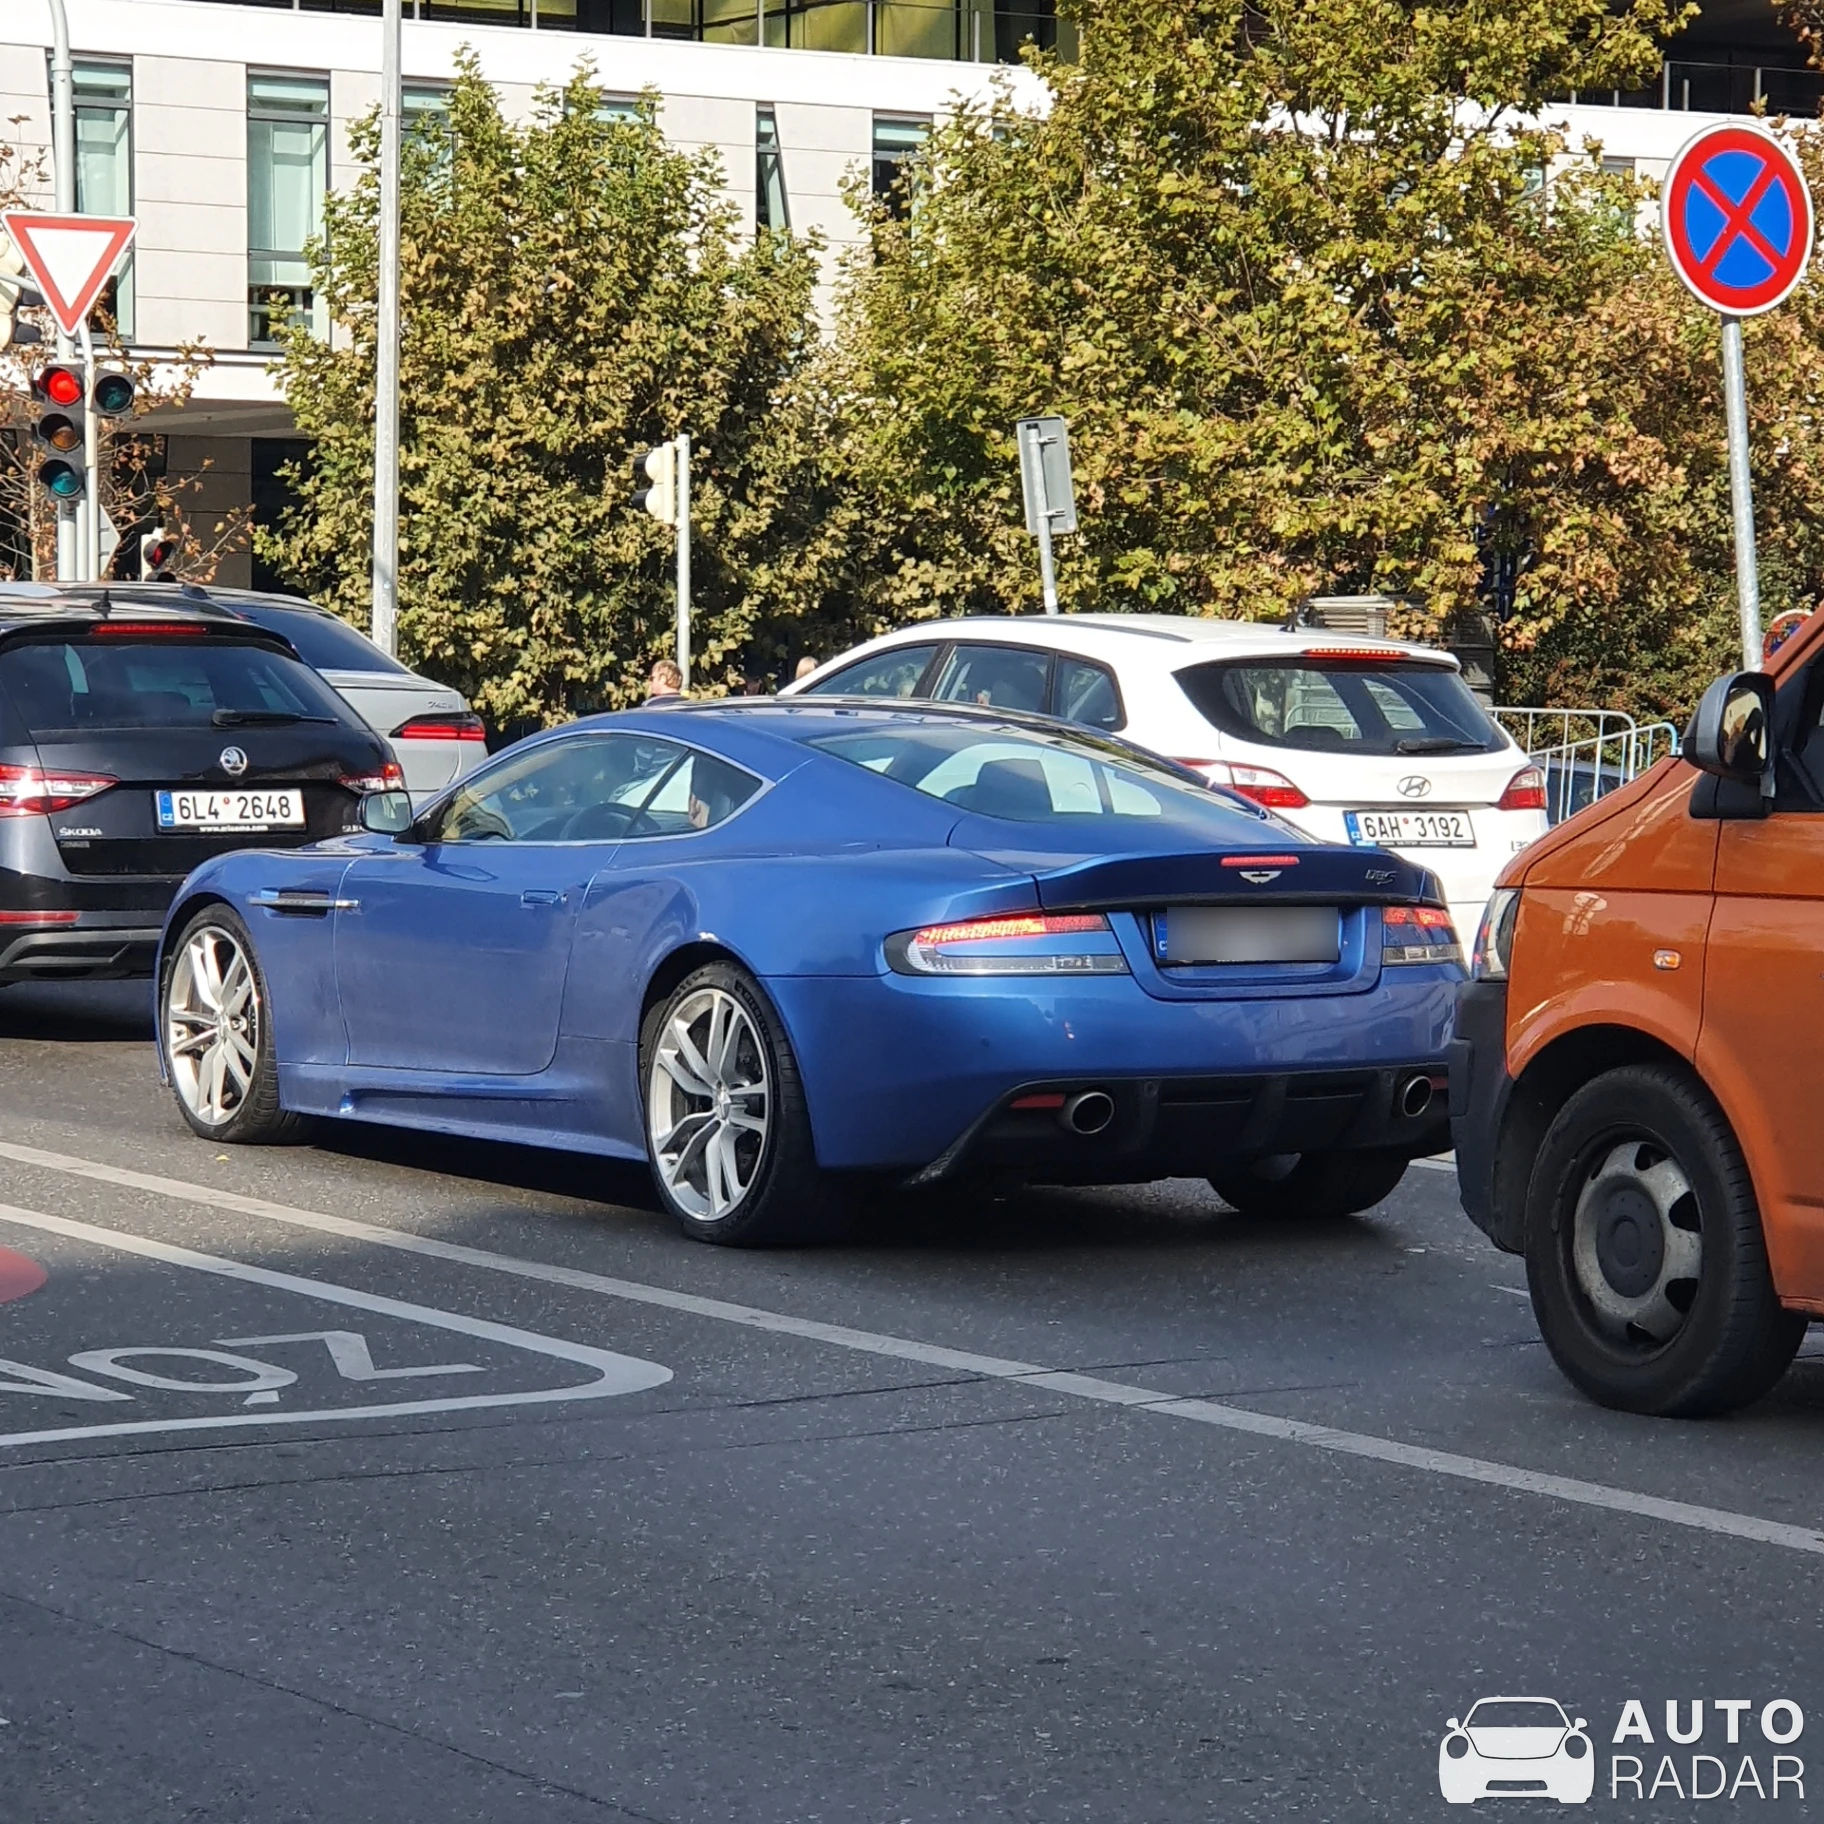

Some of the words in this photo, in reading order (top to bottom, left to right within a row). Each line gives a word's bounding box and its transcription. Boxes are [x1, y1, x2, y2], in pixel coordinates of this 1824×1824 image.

[162, 813, 174, 821] CZ
[178, 796, 220, 820] 6L4
[236, 795, 291, 819] 2648
[59, 826, 103, 836] ŠKODA
[1363, 816, 1402, 838] 6AH
[1414, 816, 1463, 838] 3192
